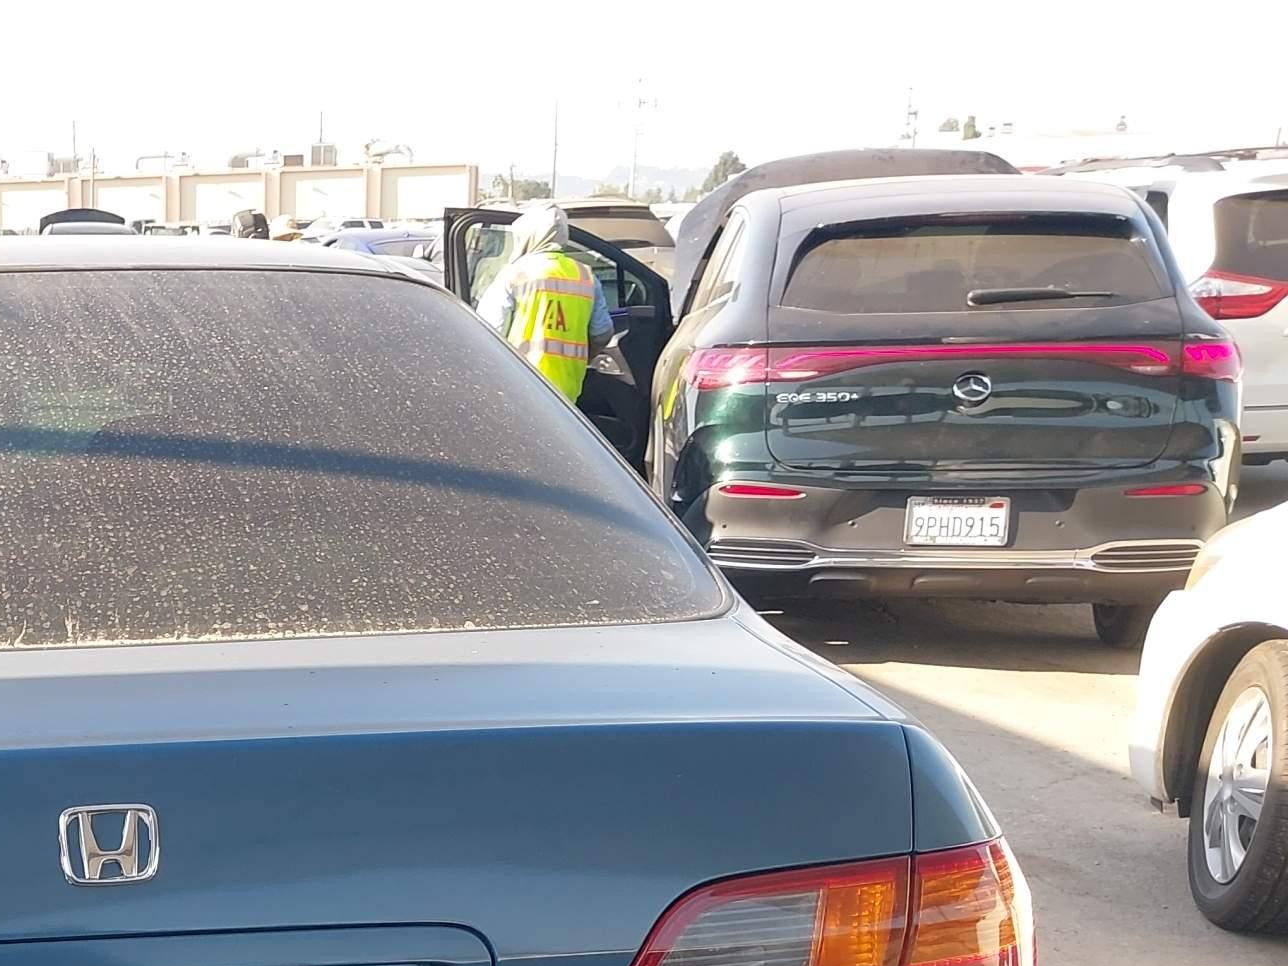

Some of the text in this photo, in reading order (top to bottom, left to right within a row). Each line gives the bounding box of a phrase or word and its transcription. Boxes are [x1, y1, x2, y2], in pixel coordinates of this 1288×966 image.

[775, 392, 859, 403] EQE 350+
[915, 516, 1000, 537] 9PHD915
